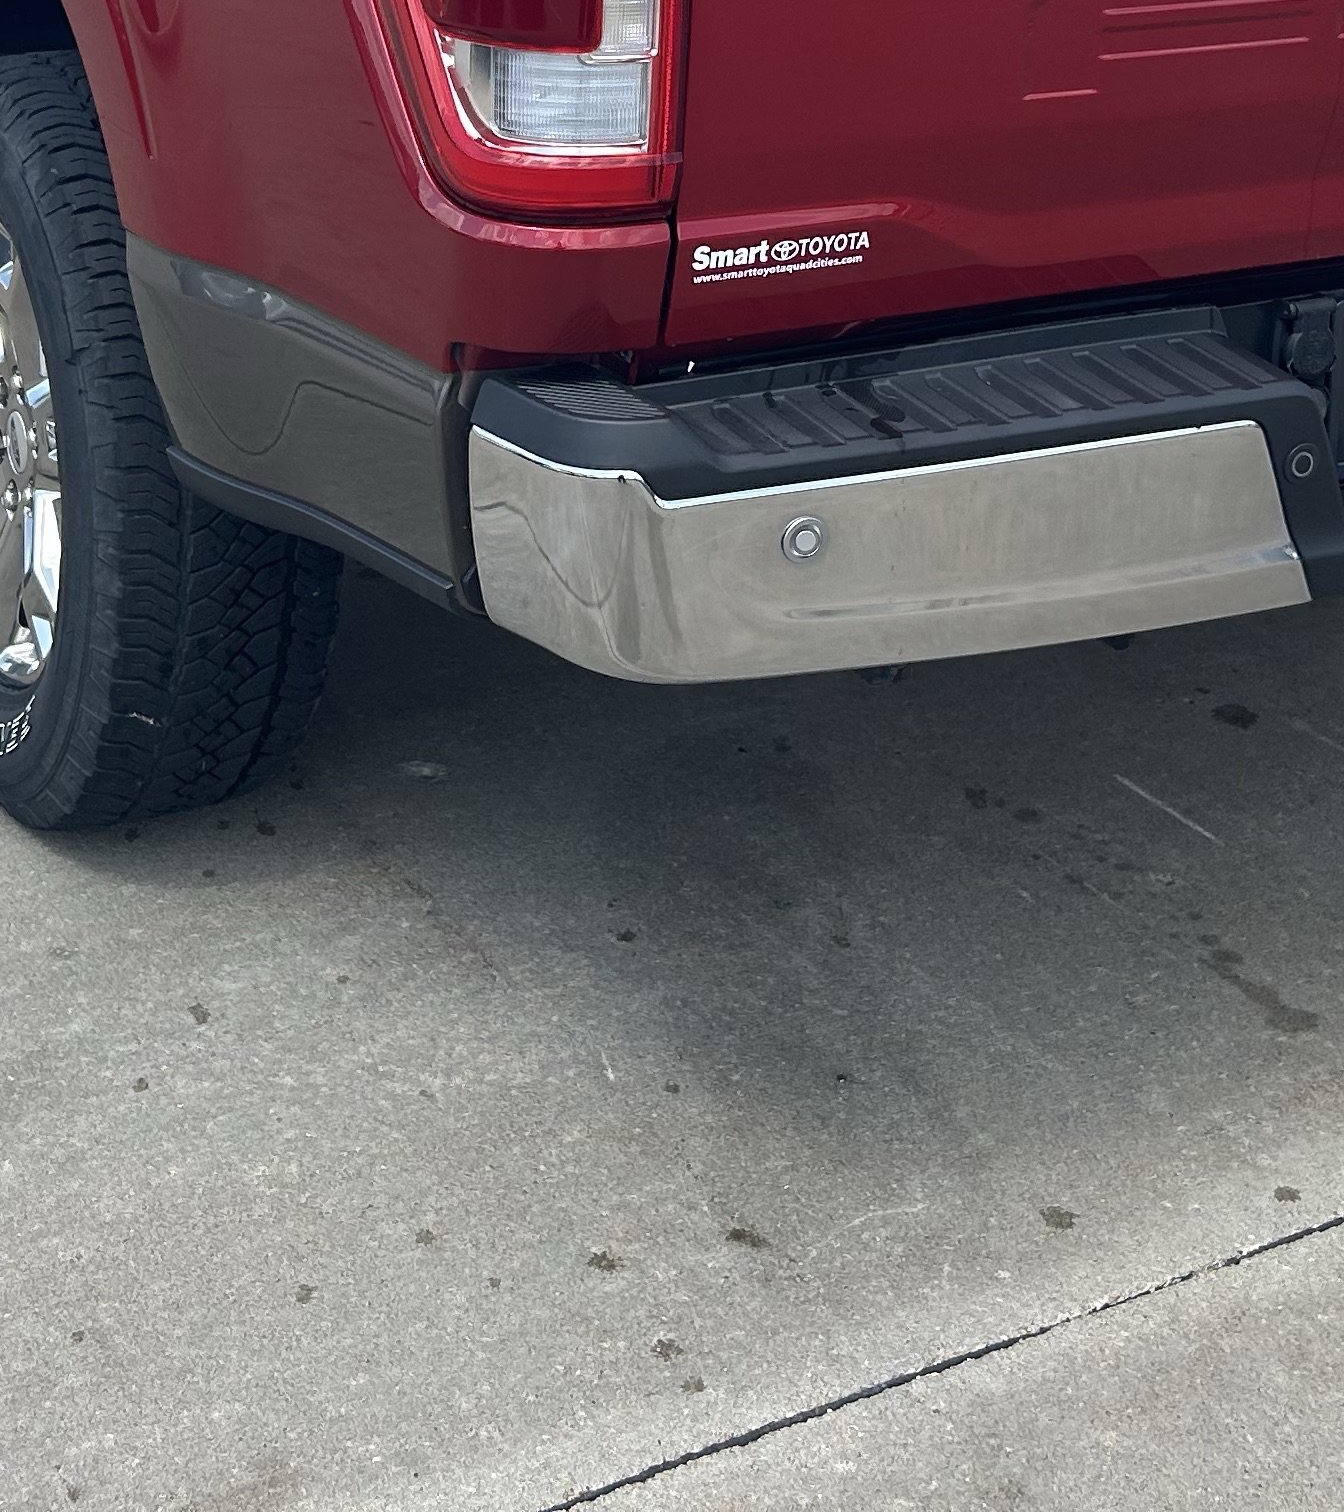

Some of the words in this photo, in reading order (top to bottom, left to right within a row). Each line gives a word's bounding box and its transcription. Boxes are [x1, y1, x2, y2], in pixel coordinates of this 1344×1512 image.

[691, 239, 771, 272] Smart
[797, 230, 871, 257] TOYOTA
[692, 254, 864, 284] www.smarttoyotaquadcities.com
